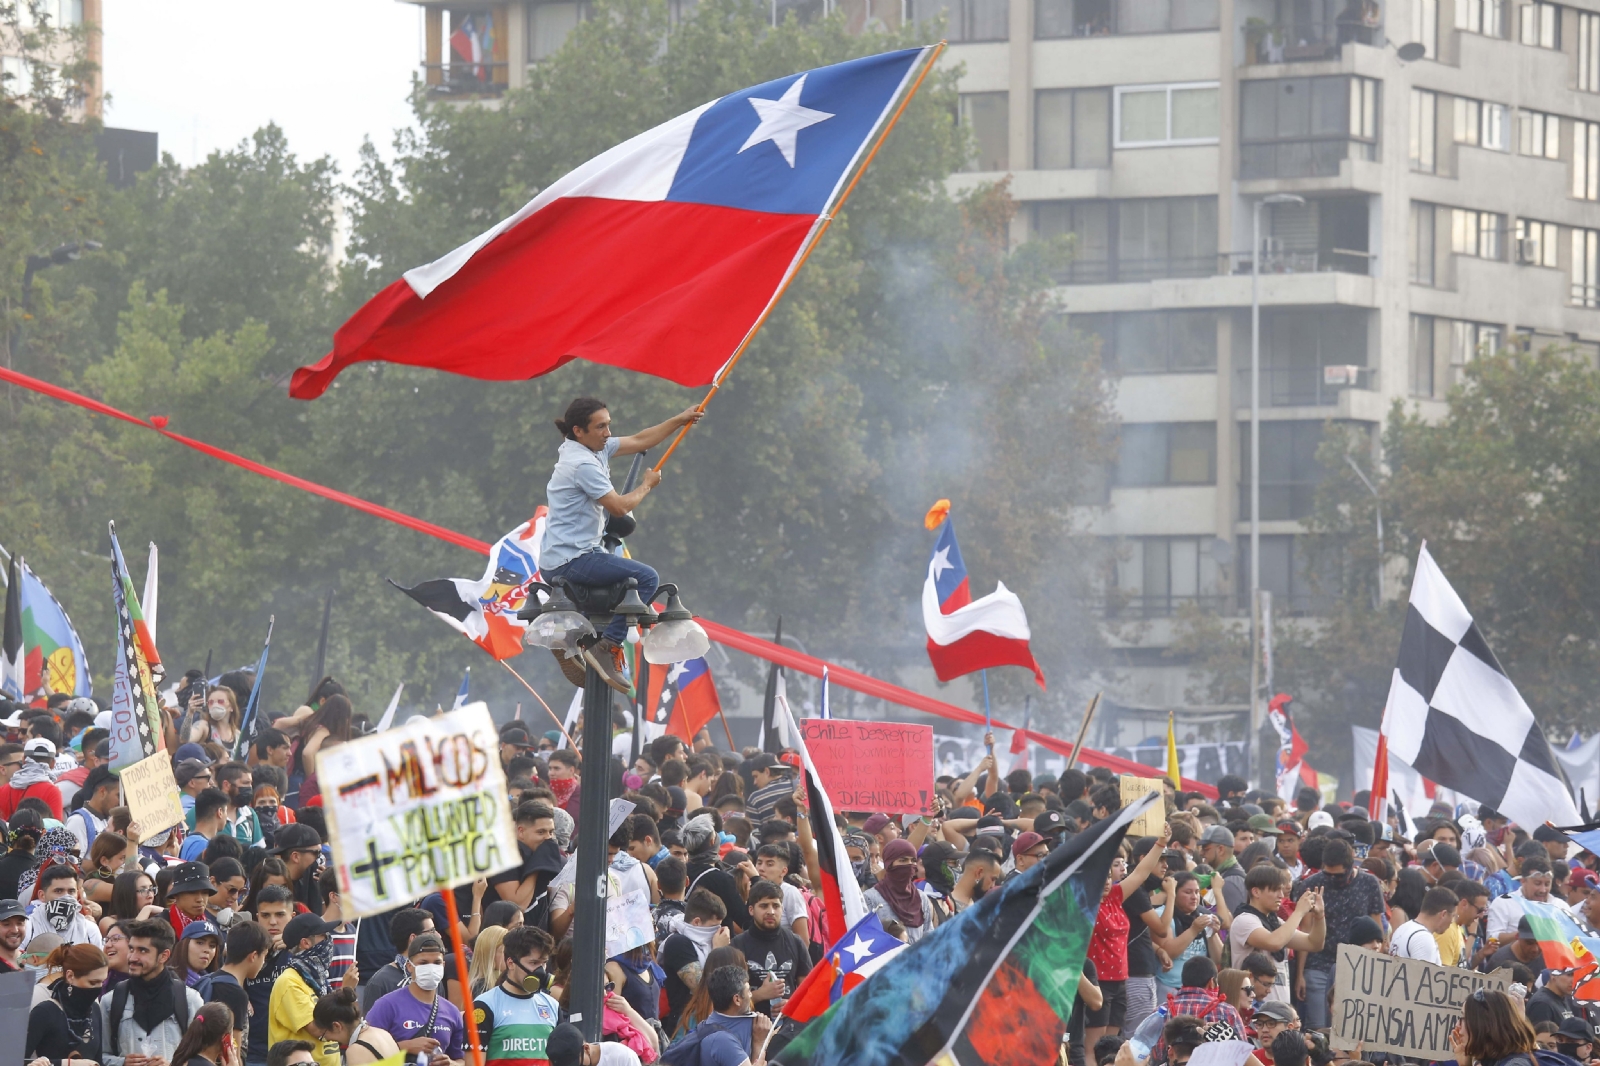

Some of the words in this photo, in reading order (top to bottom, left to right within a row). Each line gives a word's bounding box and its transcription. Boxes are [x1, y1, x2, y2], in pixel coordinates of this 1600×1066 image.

[152, 754, 169, 773] LOS
[816, 764, 844, 775] ASTA
[1344, 952, 1410, 1001] YUTA
[1341, 999, 1417, 1049] PRENSA
